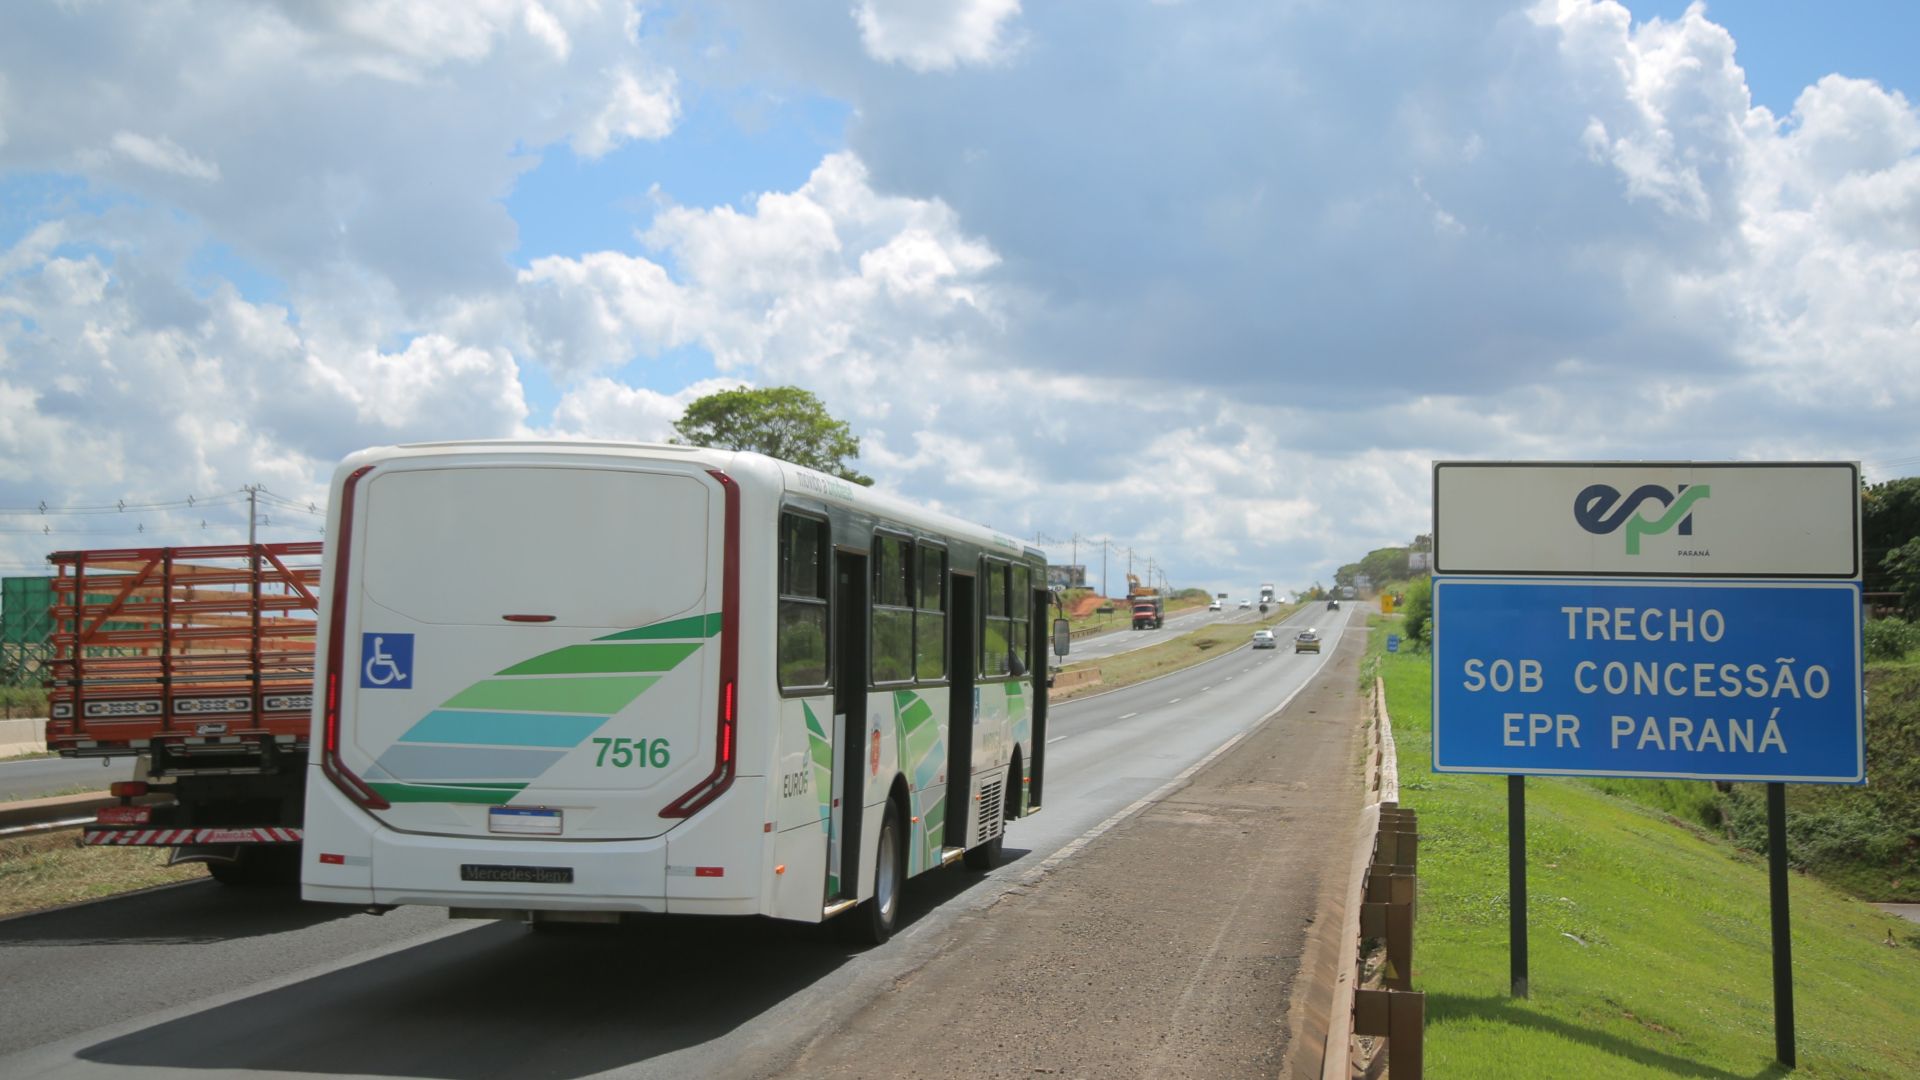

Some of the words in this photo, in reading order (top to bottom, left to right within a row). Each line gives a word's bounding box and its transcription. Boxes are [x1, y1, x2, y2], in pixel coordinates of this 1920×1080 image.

[1561, 606, 1725, 642] TRECHO
[1463, 658, 1543, 693] SOB
[1574, 657, 1830, 699] CONCESSÃO
[1503, 713, 1580, 748] EPR
[1611, 707, 1788, 754] PARANÁ
[593, 737, 670, 768] 7516
[466, 866, 569, 882] Mercedes-Benz
